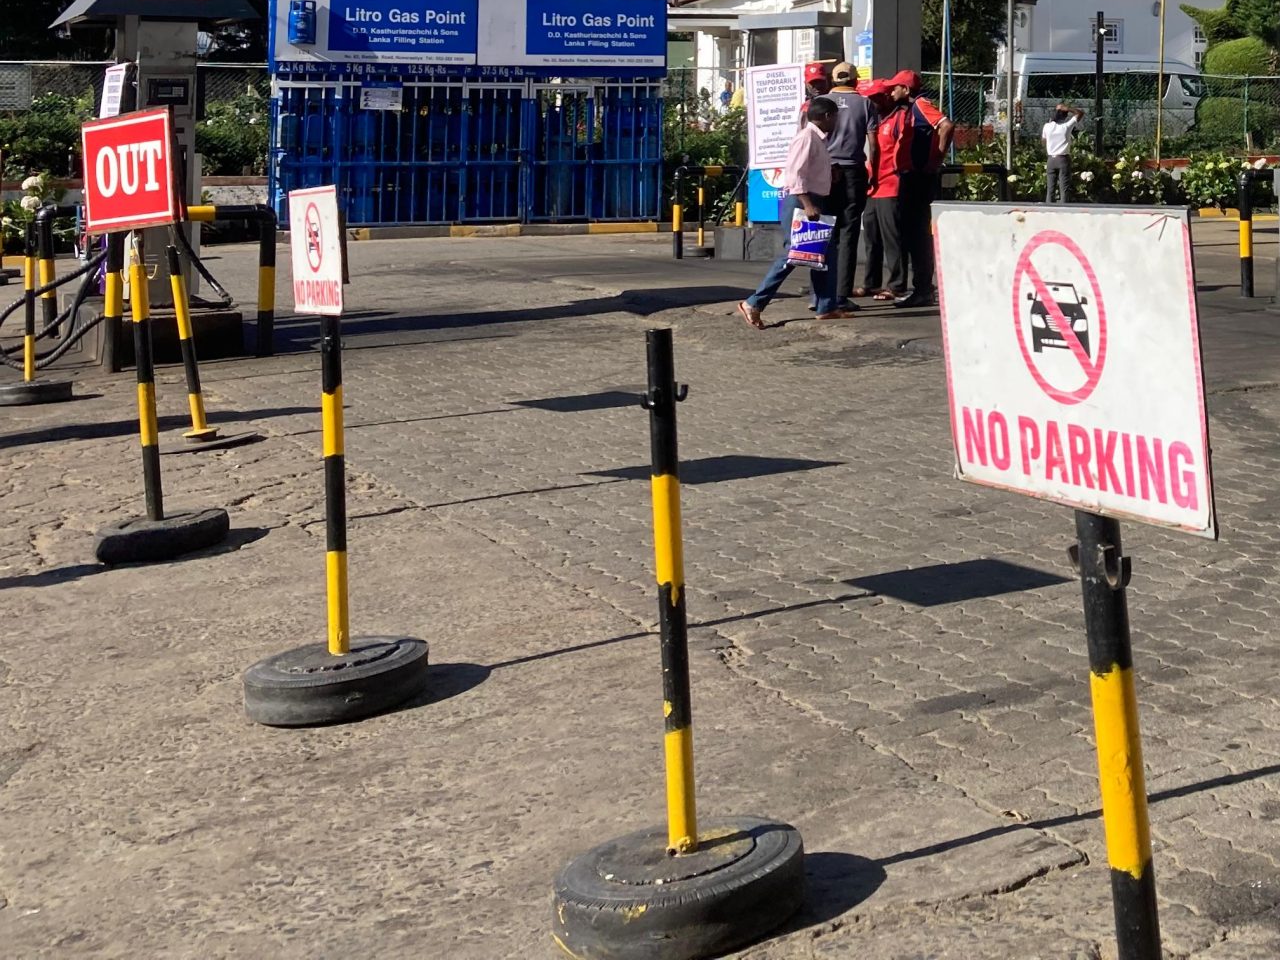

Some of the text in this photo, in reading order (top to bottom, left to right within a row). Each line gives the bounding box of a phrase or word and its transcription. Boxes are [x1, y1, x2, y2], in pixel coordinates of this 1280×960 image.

[345, 7, 466, 25] Litro Gas Point
[542, 12, 655, 28] Litro Gas Point
[393, 36, 416, 45] Filling
[588, 40, 609, 48] Filling
[611, 40, 635, 48] Station
[278, 63, 291, 72] 2.3
[292, 63, 304, 73] Kg
[346, 63, 351, 72] 5
[353, 63, 363, 75] Kg
[407, 65, 423, 74] 12.5
[499, 67, 509, 77] Kg
[514, 67, 524, 76] Rs
[766, 71, 786, 79] DIESEL
[756, 77, 797, 86] TEMPORARILY
[756, 86, 767, 94] OUT
[778, 84, 797, 92] STOCK
[95, 140, 163, 198] OUT
[762, 190, 787, 199] CEYPET
[294, 278, 340, 307] NO PARKING
[962, 406, 1199, 511] NO PARKING
